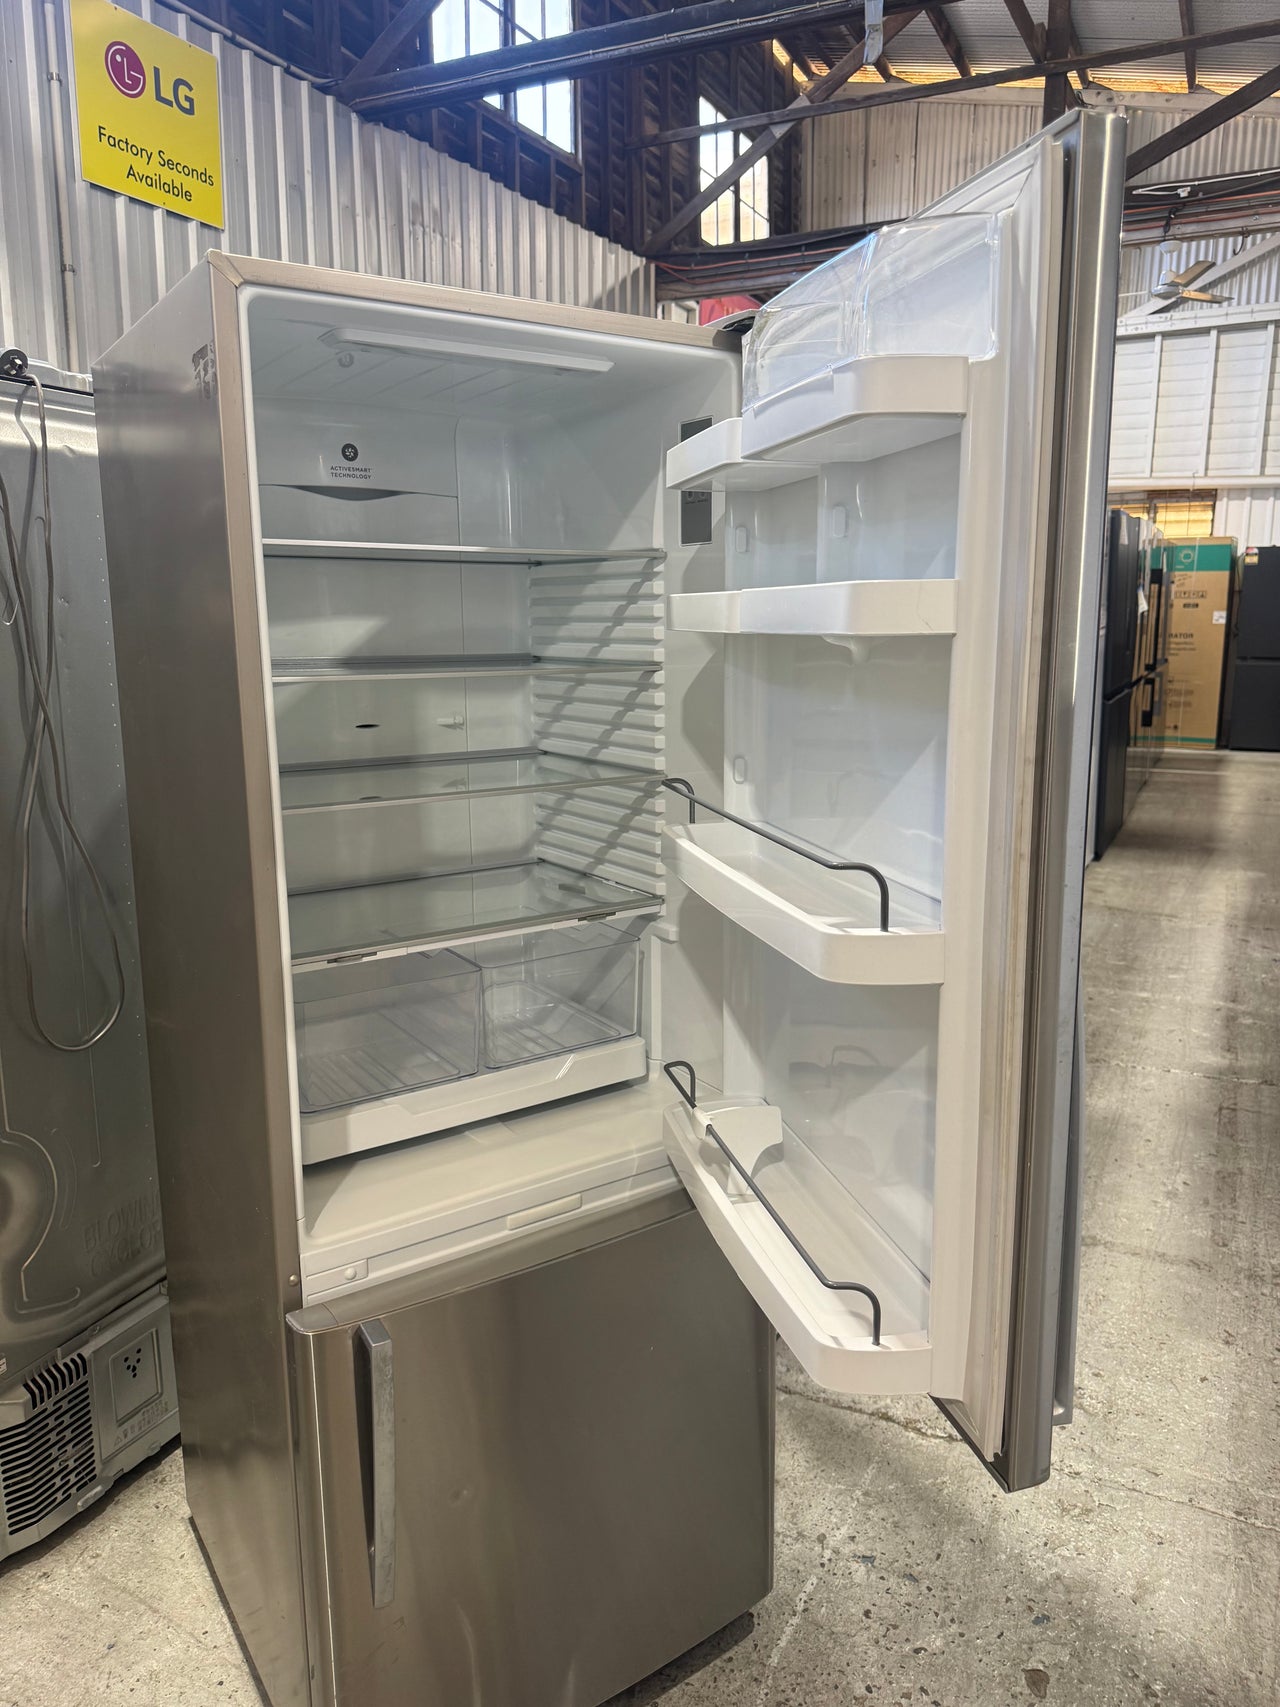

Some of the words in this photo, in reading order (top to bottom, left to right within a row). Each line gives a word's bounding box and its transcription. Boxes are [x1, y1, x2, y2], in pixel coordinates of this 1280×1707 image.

[153, 66, 195, 116] LG
[98, 126, 153, 165] Factory
[158, 150, 215, 187] Seconds
[126, 164, 193, 202] Available
[330, 472, 371, 480] TECHNOLOGY
